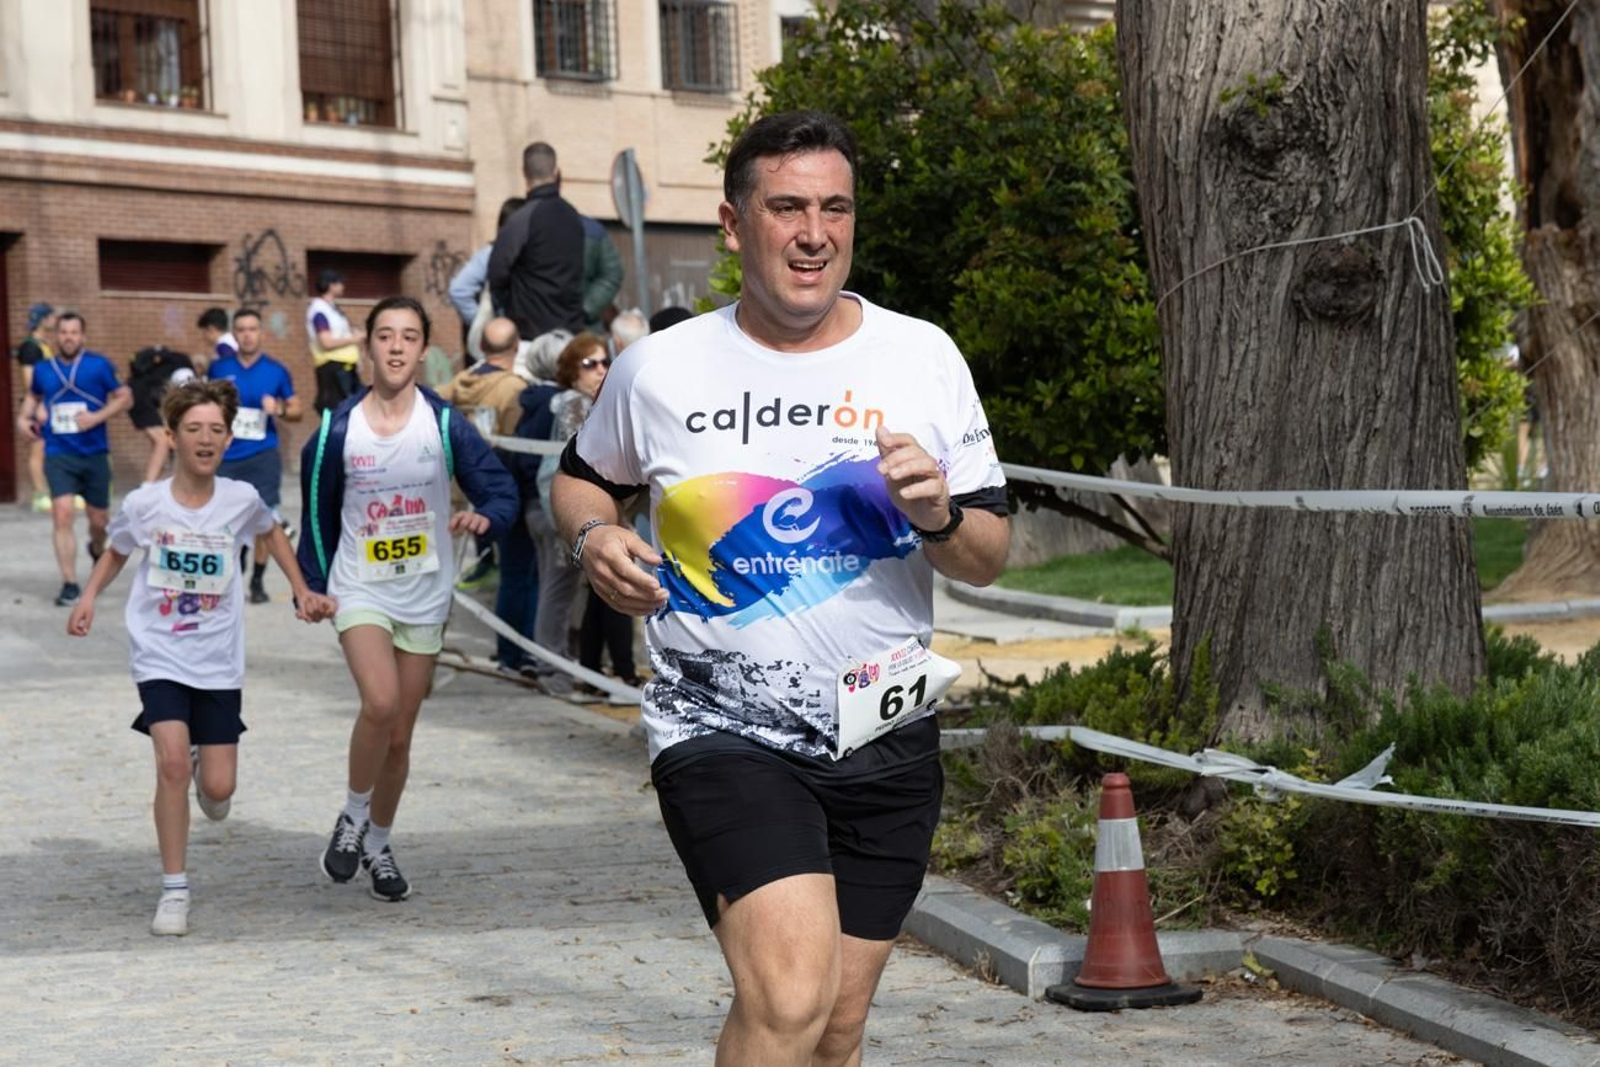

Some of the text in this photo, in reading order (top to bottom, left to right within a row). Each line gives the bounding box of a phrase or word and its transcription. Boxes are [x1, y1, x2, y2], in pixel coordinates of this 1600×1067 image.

[686, 390, 884, 445] calderón
[832, 436, 859, 445] desde
[373, 535, 422, 562] 655
[166, 551, 218, 576] 656
[733, 549, 860, 576] entrénate
[879, 674, 927, 721] 61
